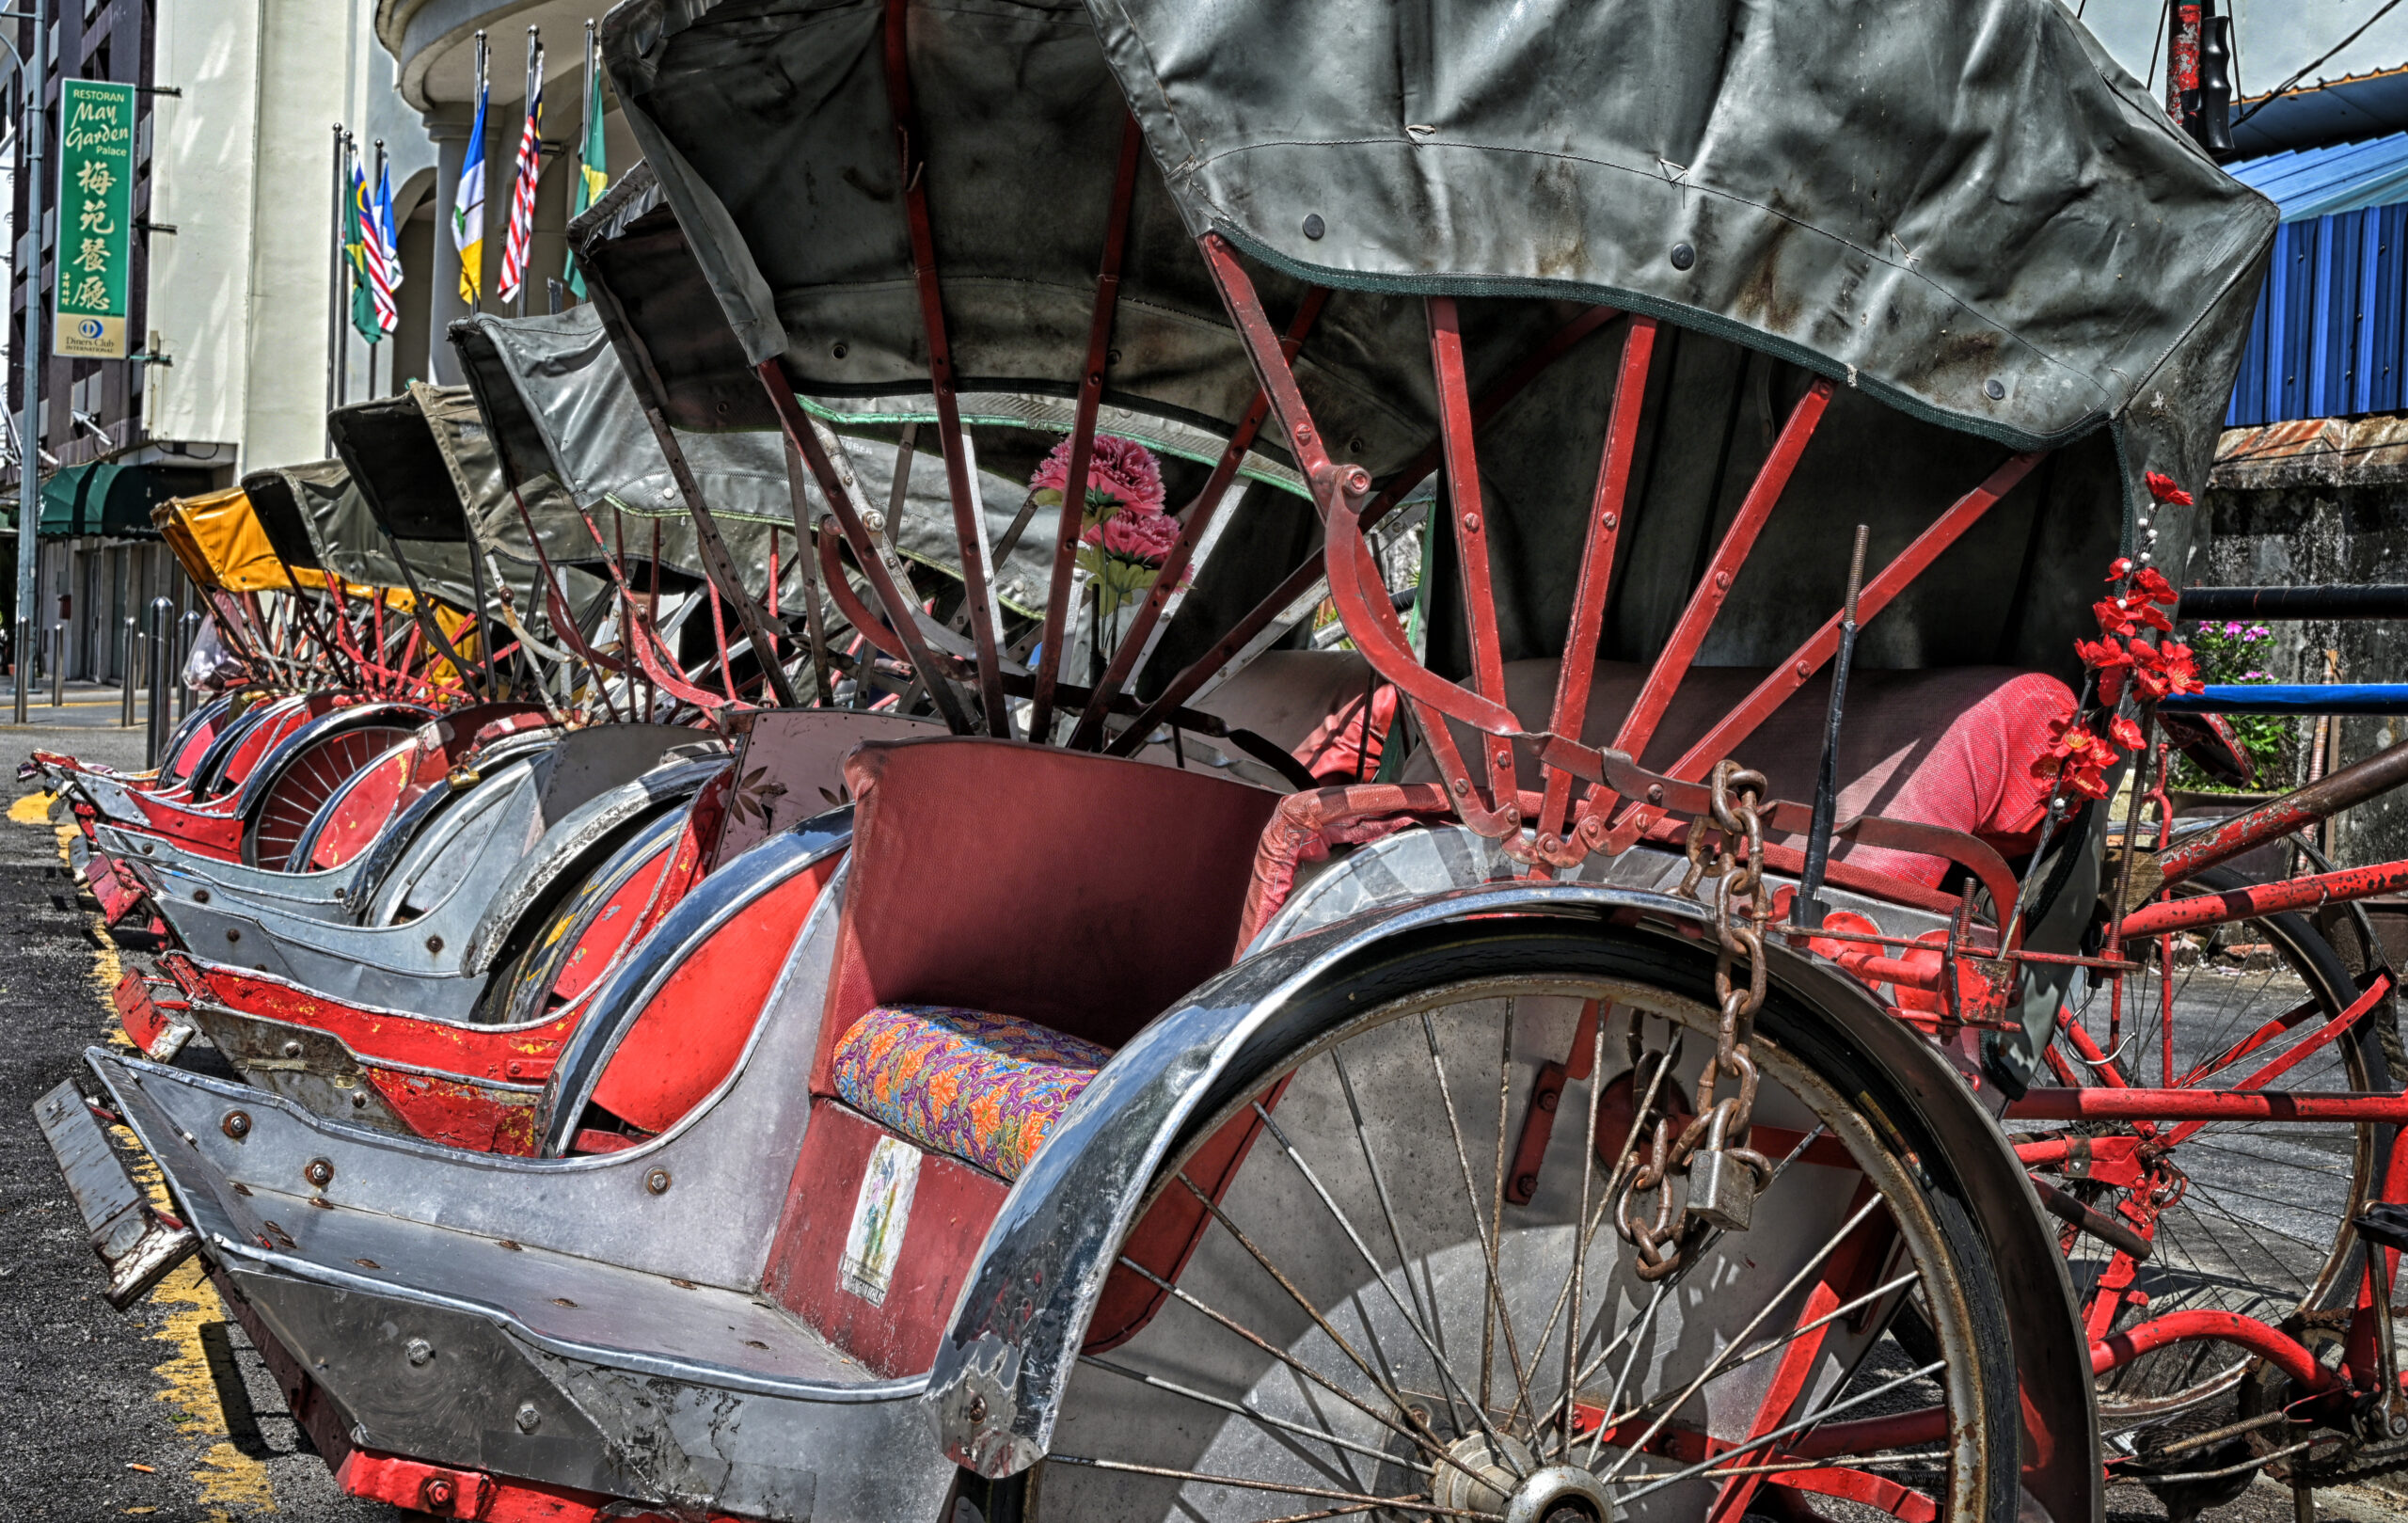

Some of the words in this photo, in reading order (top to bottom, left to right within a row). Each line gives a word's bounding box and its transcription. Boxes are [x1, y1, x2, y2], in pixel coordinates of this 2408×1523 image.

[73, 89, 124, 103] RESTORAN
[71, 102, 117, 128] May
[65, 124, 129, 152] Garden
[96, 146, 127, 156] Palace
[66, 337, 93, 346] Diners
[94, 339, 115, 348] Club
[66, 345, 113, 354] INTERNATIONAL
